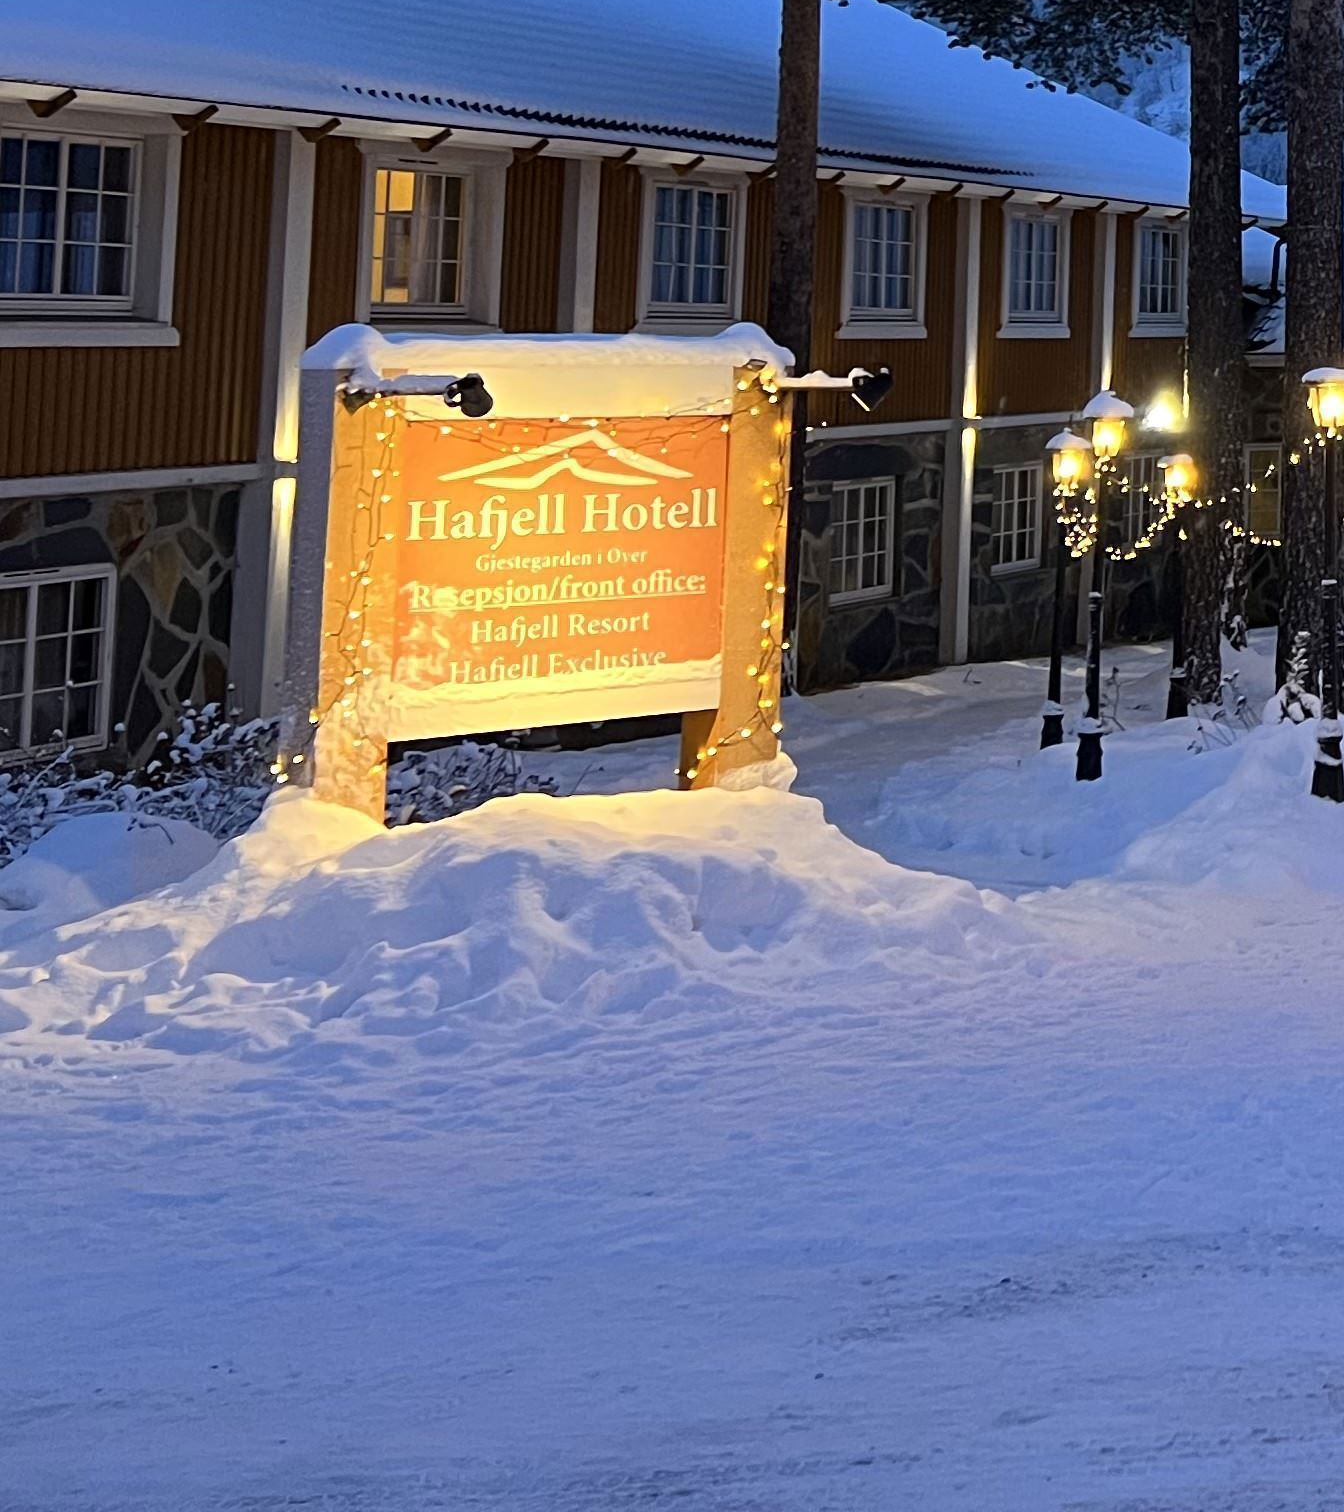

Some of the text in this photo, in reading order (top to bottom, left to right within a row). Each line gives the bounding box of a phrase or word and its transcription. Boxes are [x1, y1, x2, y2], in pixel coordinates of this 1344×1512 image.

[405, 488, 717, 550] Hafjell Hotell
[475, 551, 591, 573] Gjestegarden
[631, 569, 705, 594] office:
[470, 612, 650, 647] Hafjell Resort
[548, 647, 667, 676] Exclusive
